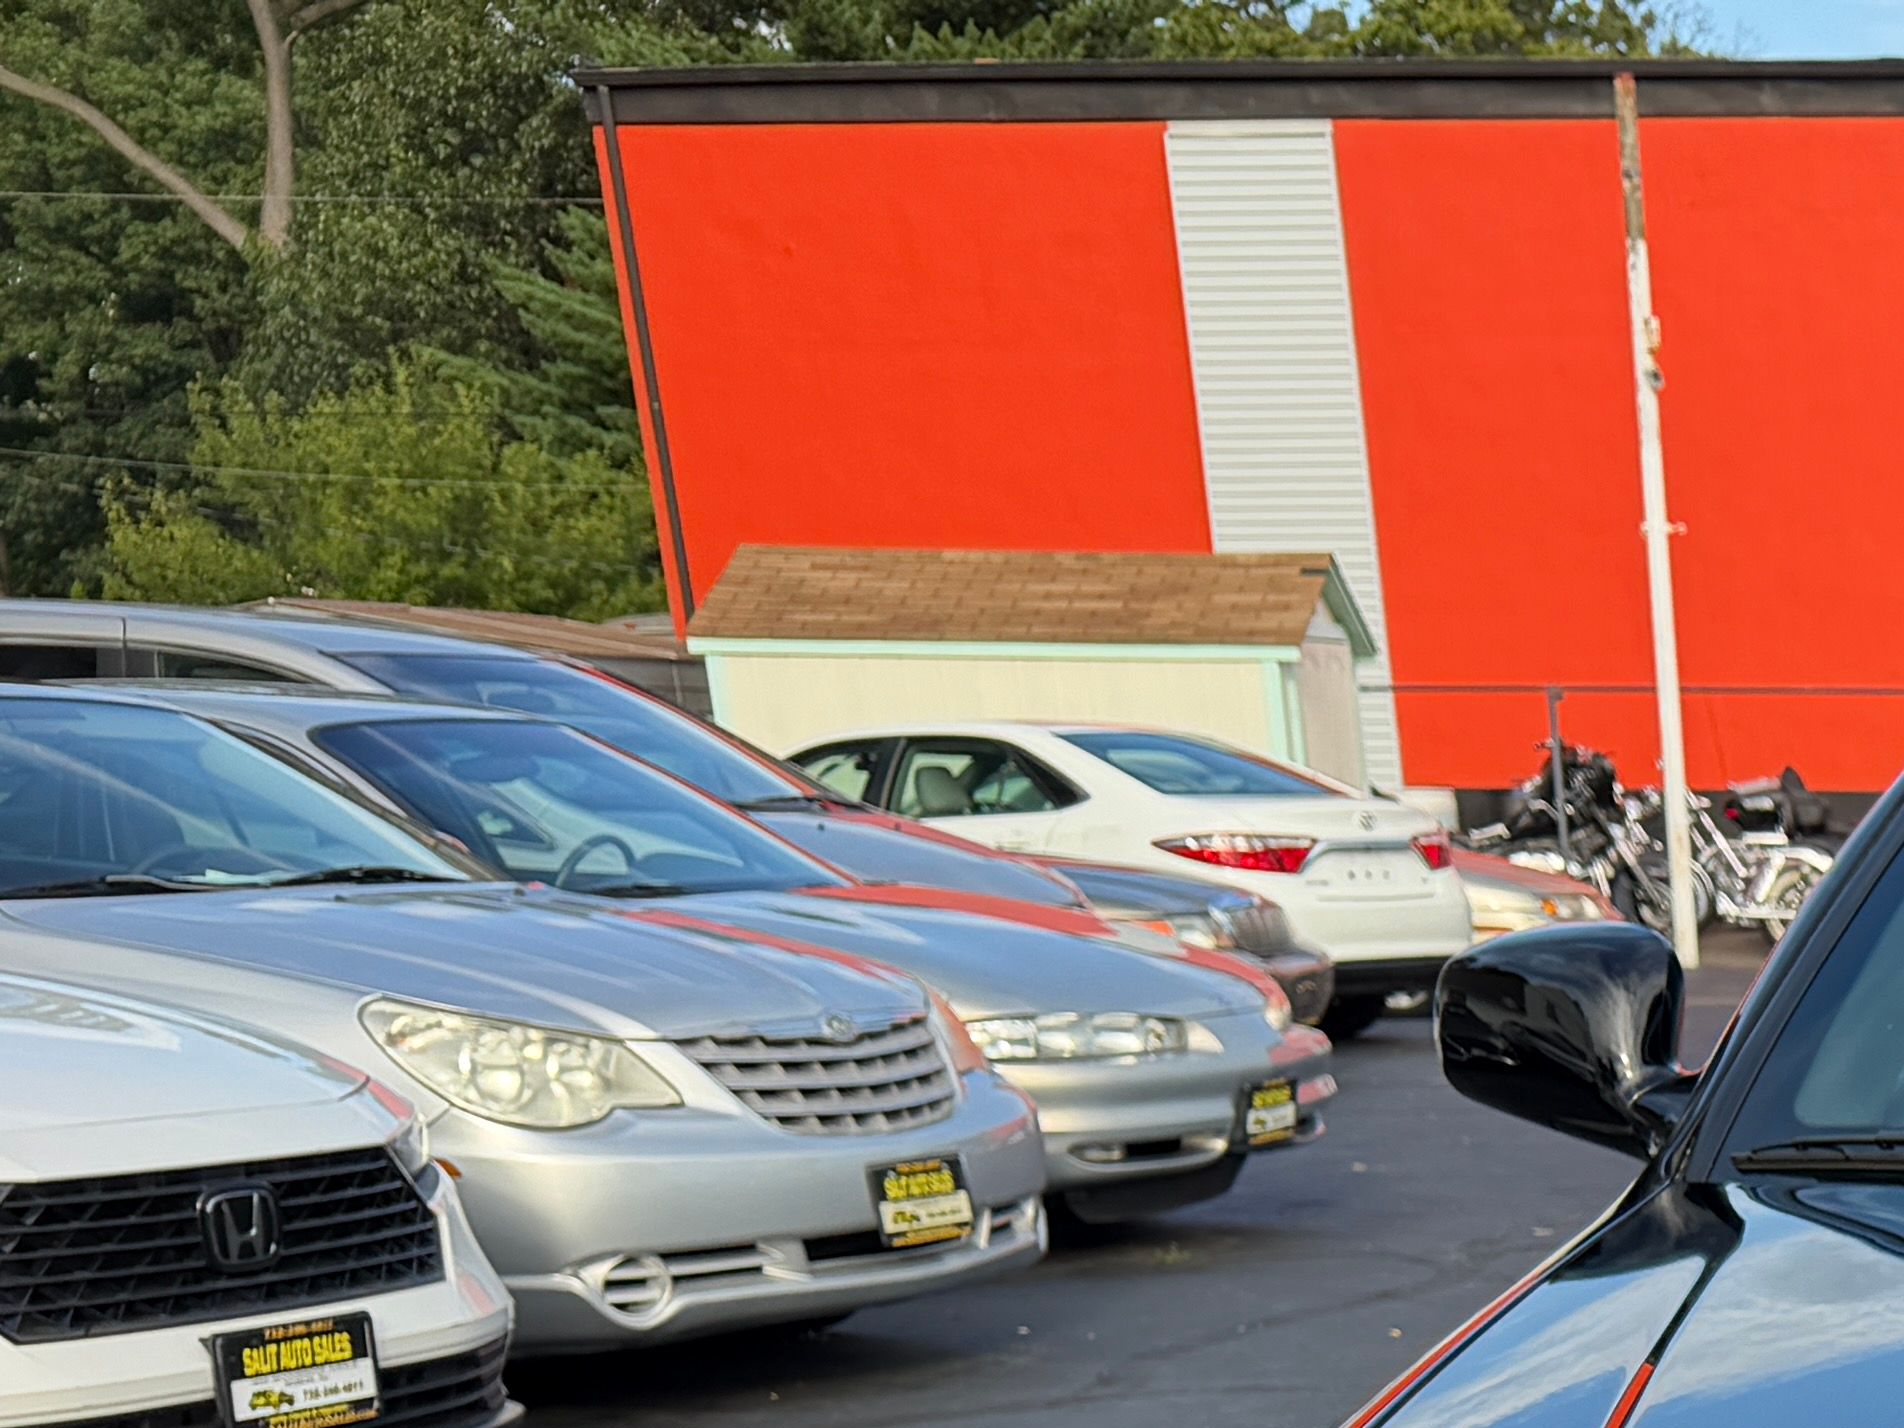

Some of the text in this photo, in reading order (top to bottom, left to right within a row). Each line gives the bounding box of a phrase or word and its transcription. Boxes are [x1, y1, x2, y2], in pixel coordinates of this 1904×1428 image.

[242, 1343, 279, 1377] SALIT
[280, 1338, 313, 1371] AUTO
[312, 1331, 353, 1365] SALES
